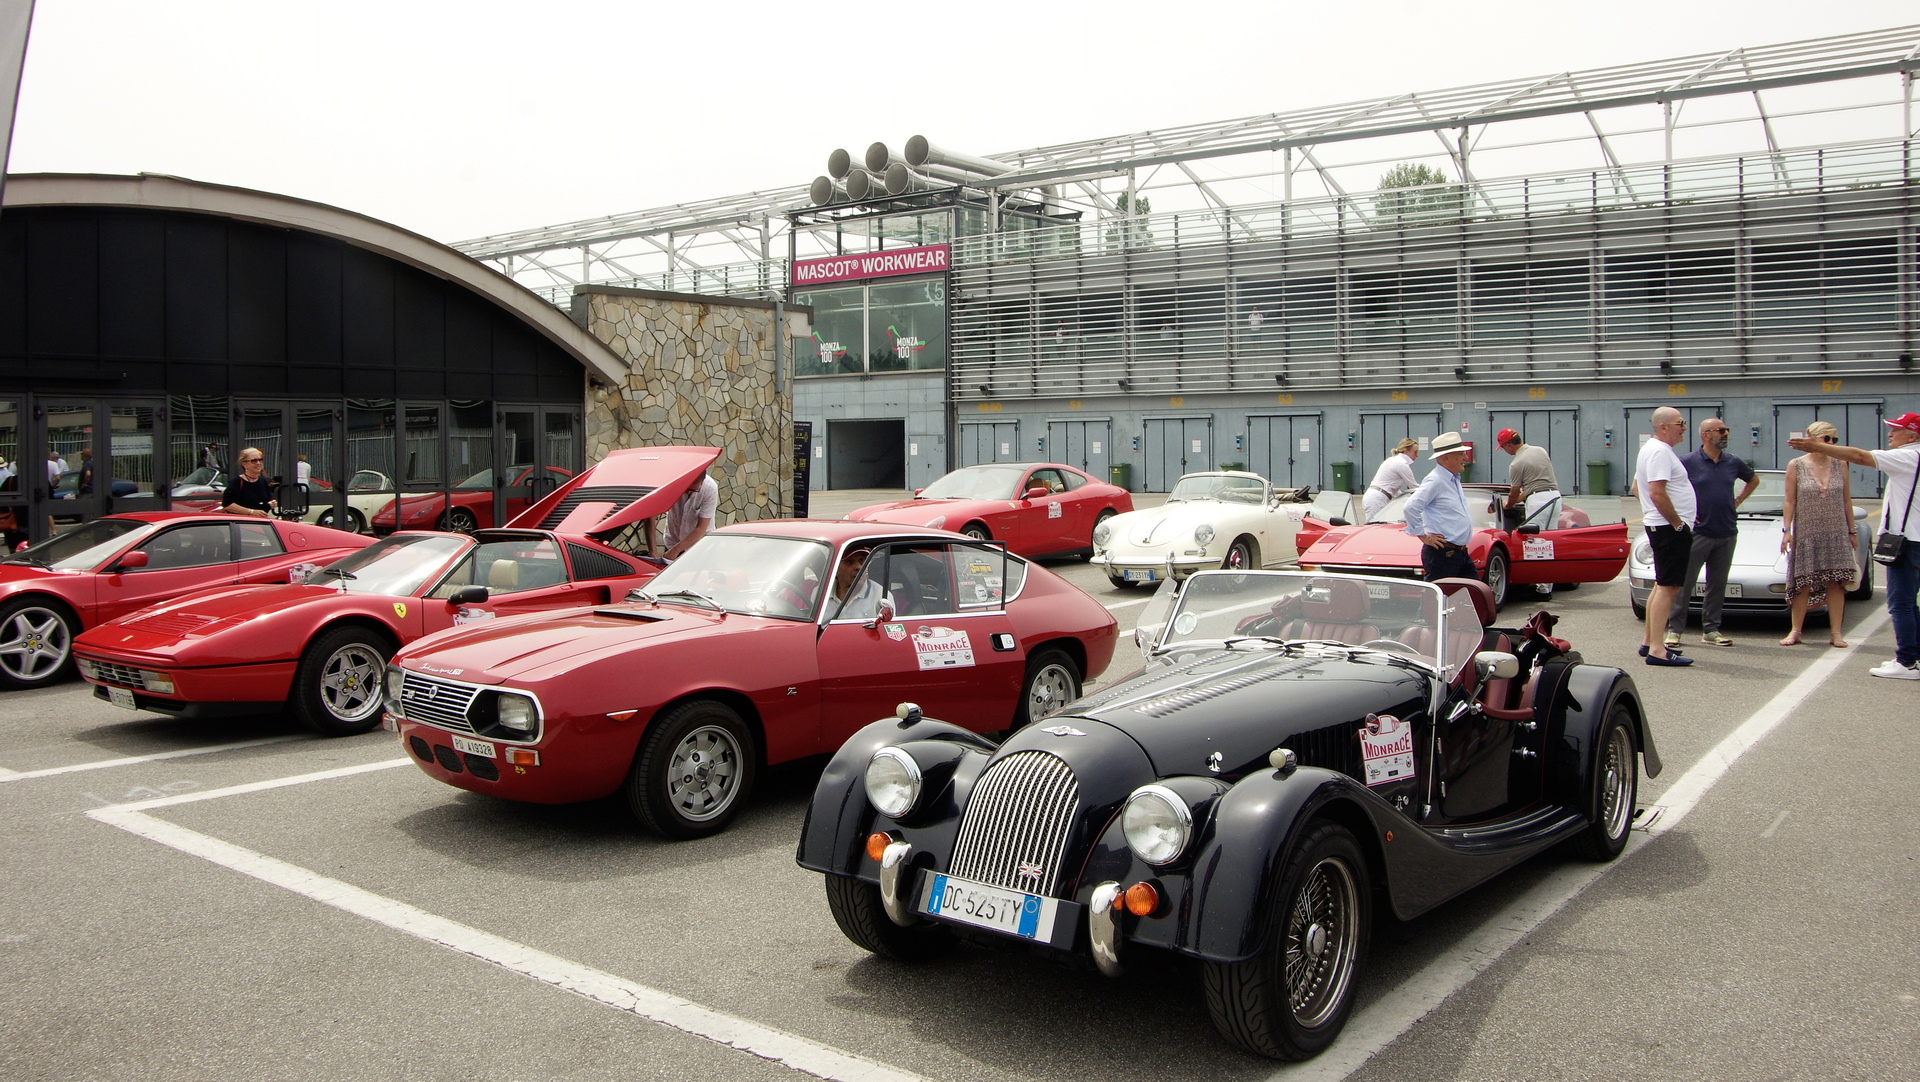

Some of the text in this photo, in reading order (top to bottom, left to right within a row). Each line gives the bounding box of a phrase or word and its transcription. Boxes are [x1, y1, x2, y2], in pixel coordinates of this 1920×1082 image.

[861, 250, 946, 274] WORKWEAR
[820, 341, 841, 352] MONZA
[897, 336, 919, 347] MONZA
[820, 351, 833, 364] 100
[897, 346, 910, 359] 100
[1667, 383, 1687, 396] 56
[1821, 380, 1843, 392] 57
[1278, 393, 1294, 405] 53
[1391, 391, 1408, 402] 54
[1528, 387, 1547, 399] 55
[1069, 400, 1082, 411] 51
[1169, 397, 1184, 407] 52
[917, 637, 969, 653] MONRACE
[1364, 731, 1411, 759] MONRACE
